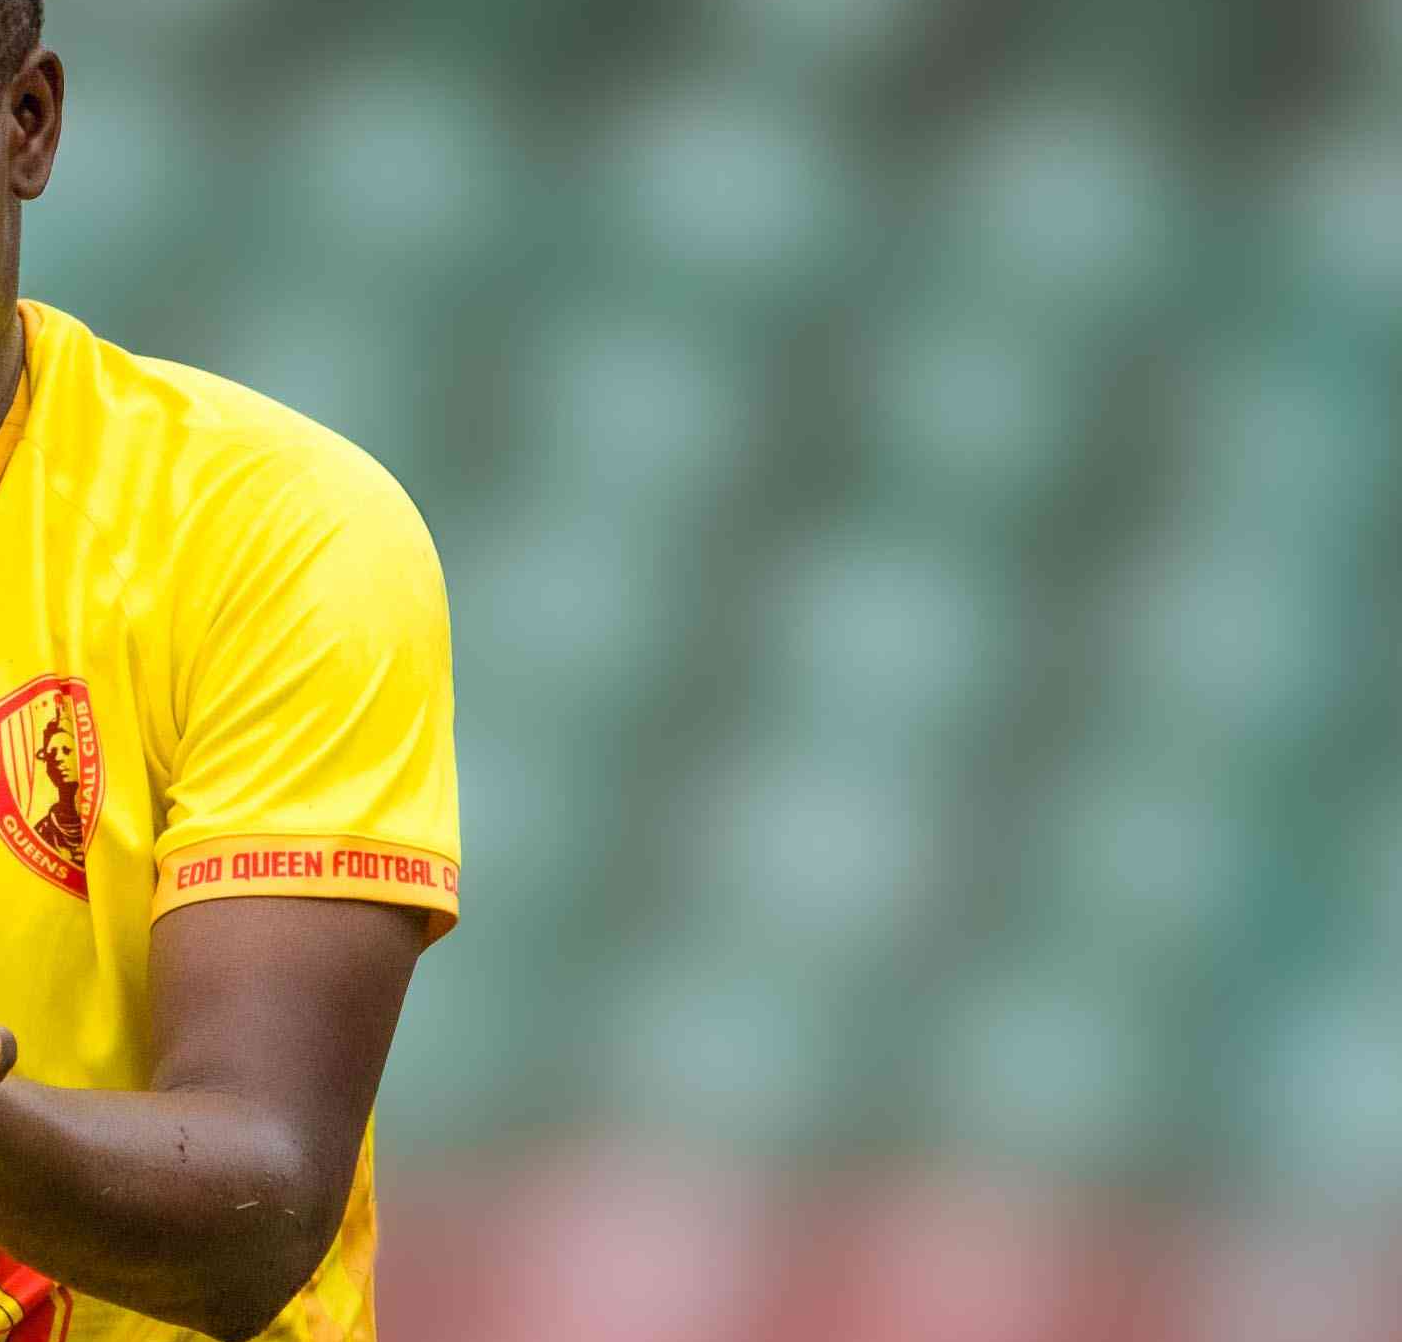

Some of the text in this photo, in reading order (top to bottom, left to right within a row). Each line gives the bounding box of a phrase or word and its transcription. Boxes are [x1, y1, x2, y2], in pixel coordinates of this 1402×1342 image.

[2, 813, 69, 880] QUEENS
[176, 856, 223, 891] EDO
[232, 850, 323, 882] QUEEN
[332, 850, 438, 888] FOOTBAL
